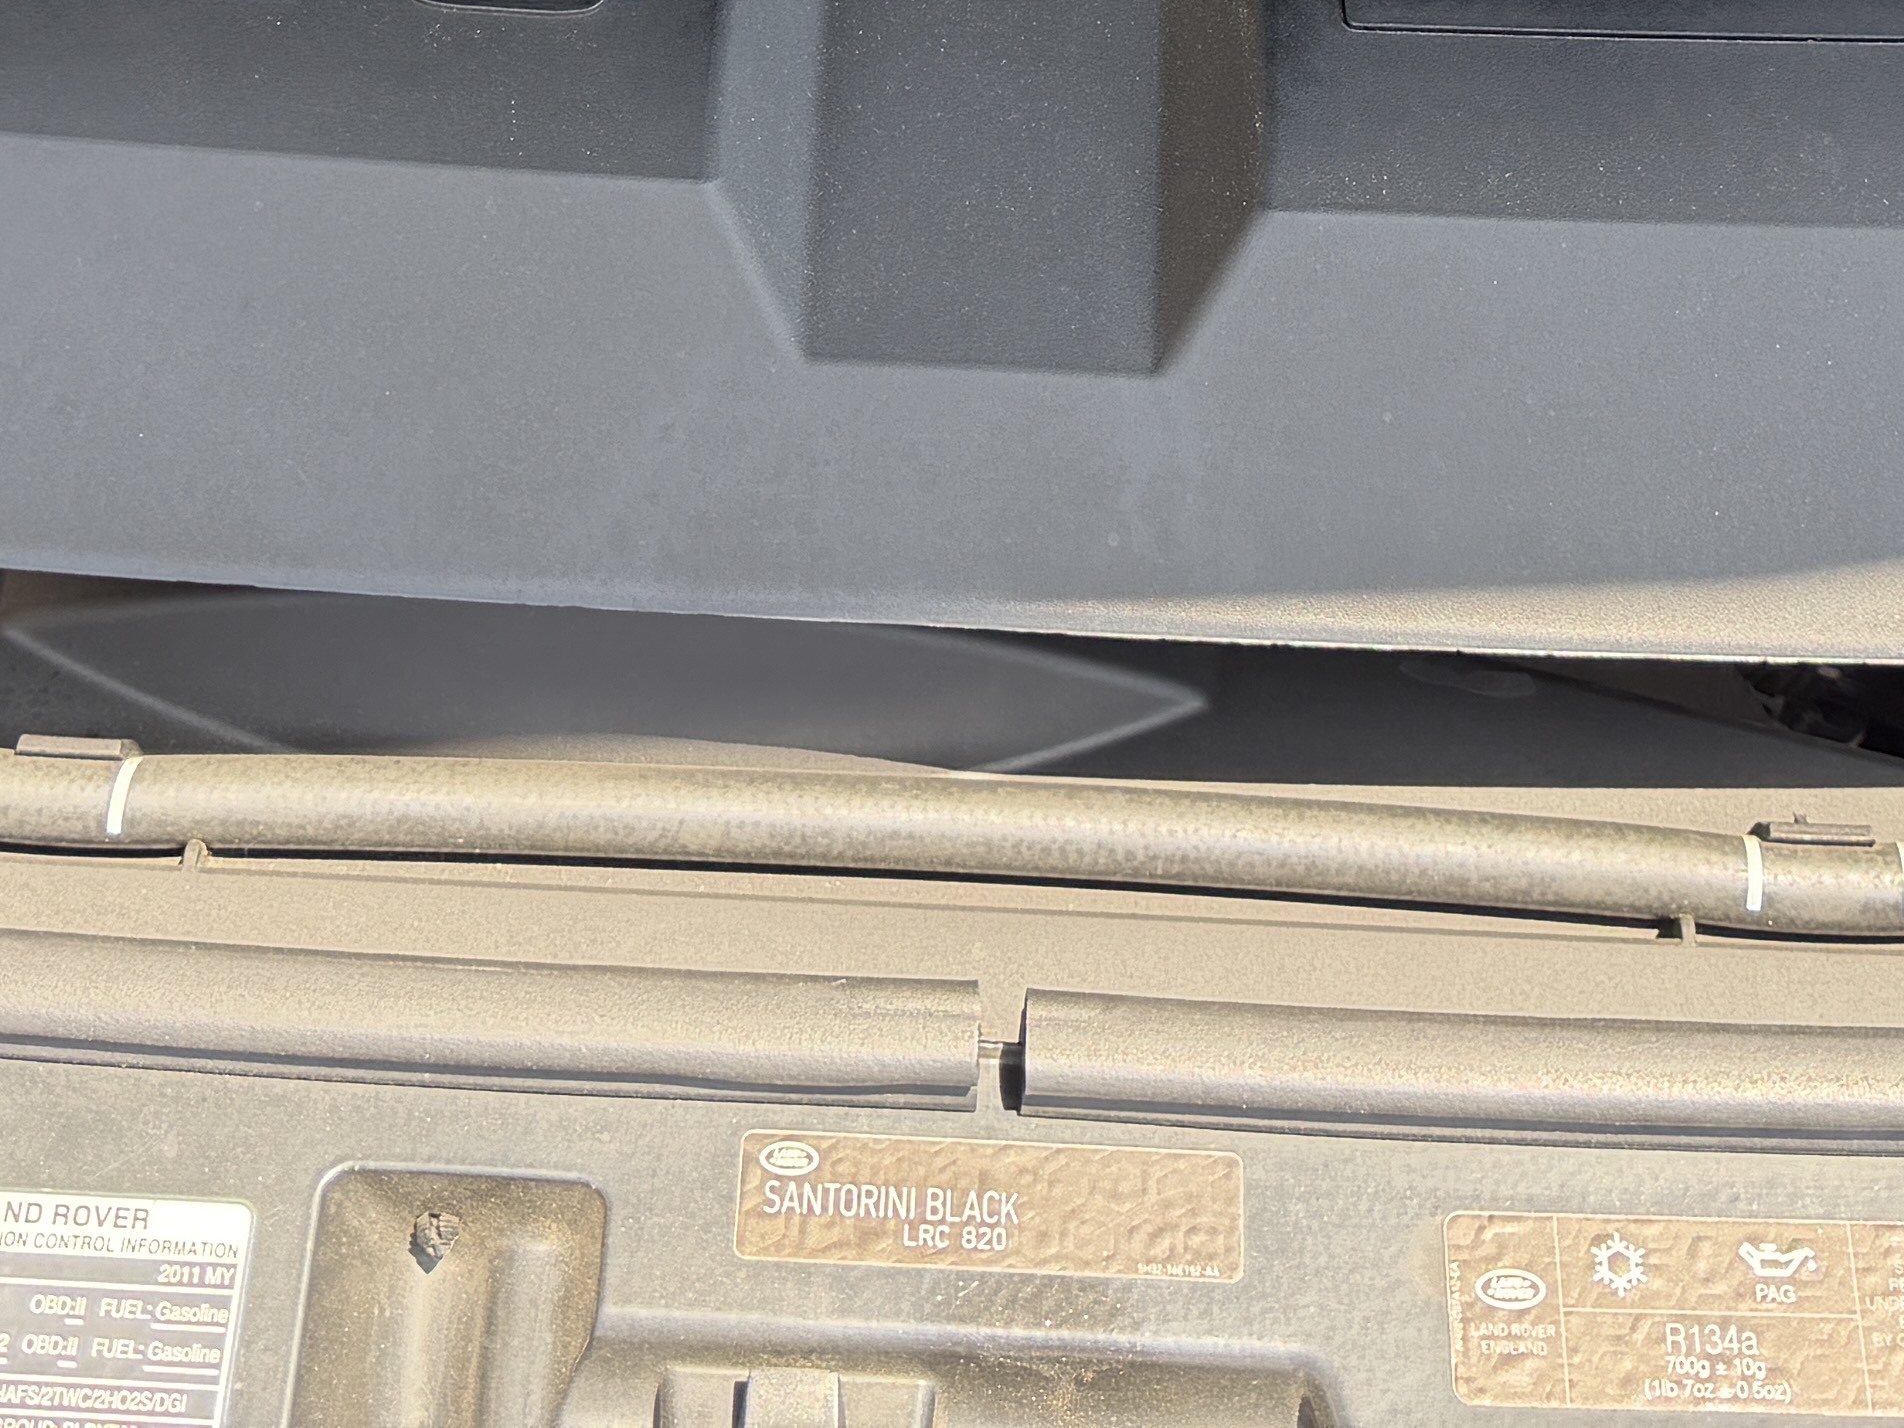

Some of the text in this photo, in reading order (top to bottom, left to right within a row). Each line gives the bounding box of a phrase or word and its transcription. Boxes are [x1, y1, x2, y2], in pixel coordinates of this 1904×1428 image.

[762, 1179, 1019, 1225] SANTORINI BLACK
[52, 1203, 149, 1230] ROVER
[33, 1232, 115, 1253] CONTROL
[120, 1236, 239, 1259] INFORMATION
[903, 1223, 1008, 1251] LRC 820
[157, 1263, 235, 1287] 2011 MY
[1755, 1283, 1797, 1304] PAG
[155, 1301, 229, 1324] Gasoline
[1469, 1322, 1557, 1339] LAND ROVER
[1664, 1322, 1761, 1356] R134a
[1871, 1332, 1894, 1347] BY
[147, 1341, 222, 1363] Gasoline
[1480, 1339, 1548, 1357] ENGLAND
[1664, 1356, 1711, 1379] 700g
[1733, 1357, 1767, 1380] 10g
[1681, 1379, 1716, 1399] 7oz
